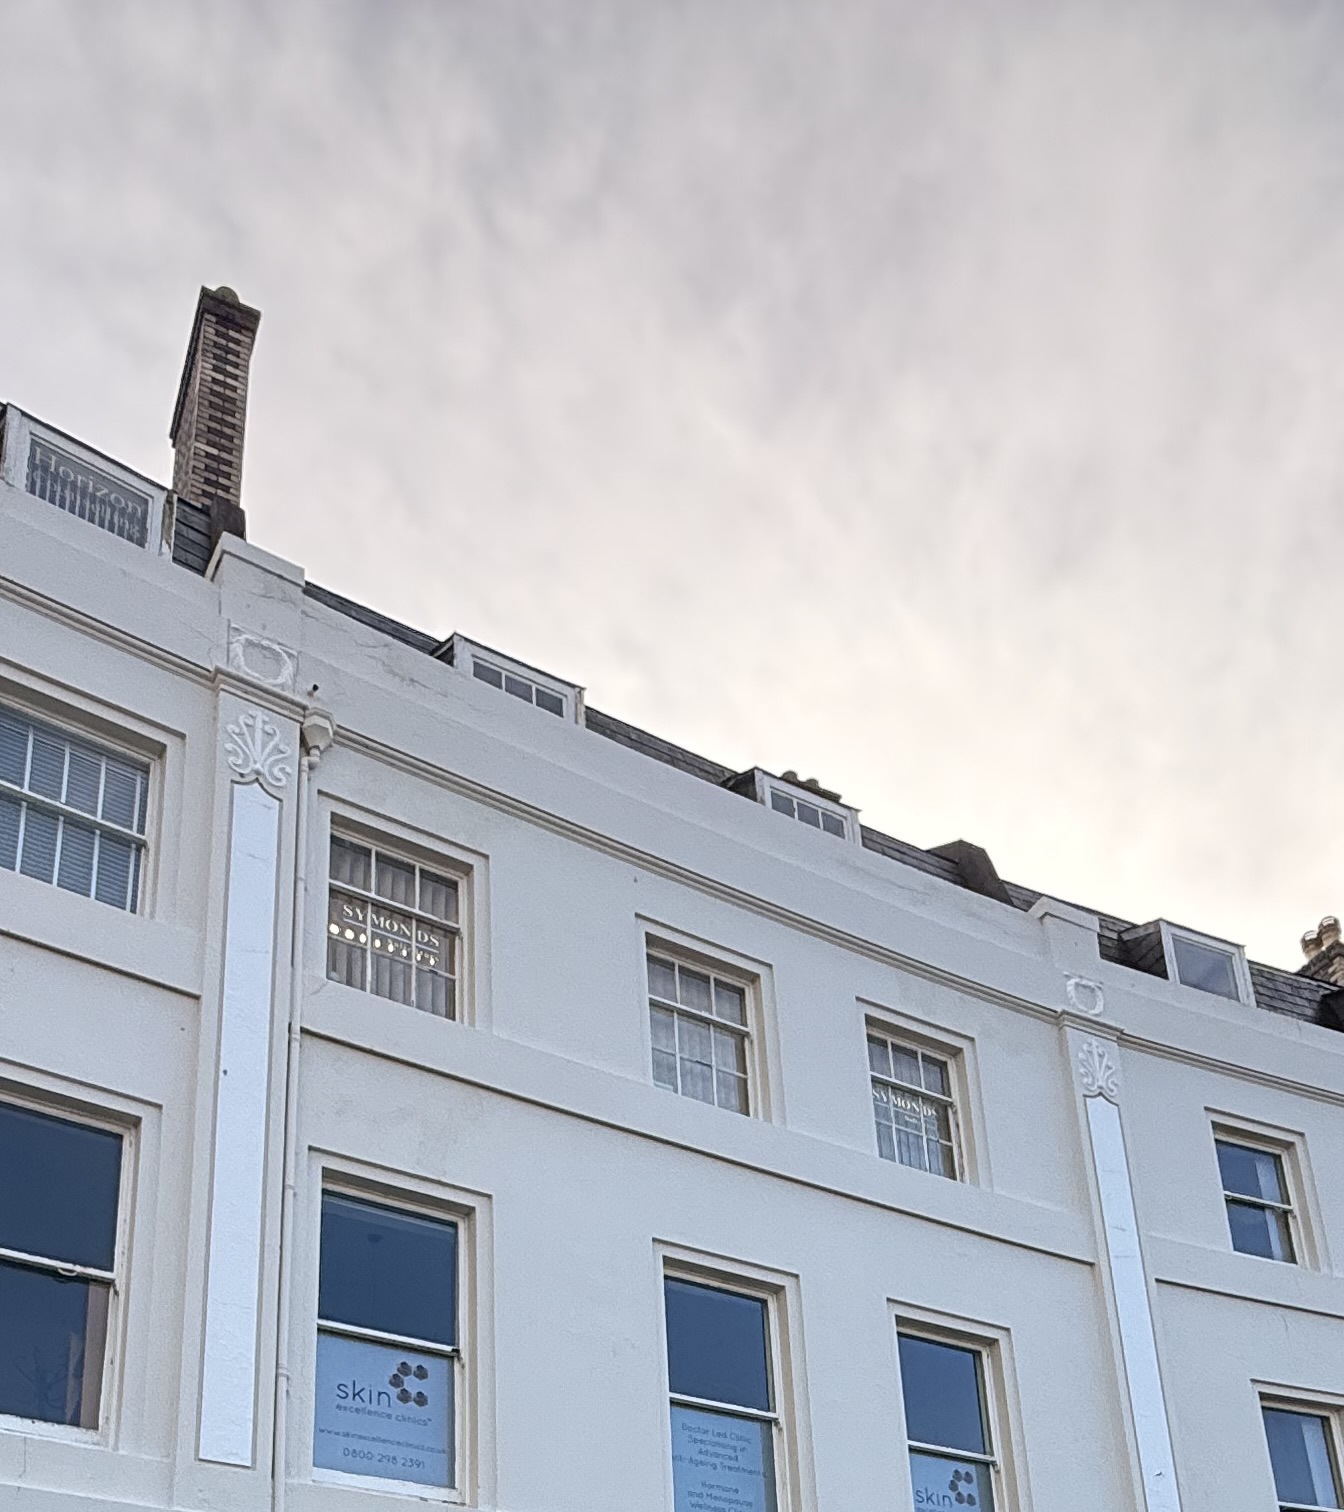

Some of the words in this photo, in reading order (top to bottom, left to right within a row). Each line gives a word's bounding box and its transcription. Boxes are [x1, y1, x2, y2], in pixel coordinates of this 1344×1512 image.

[34, 446, 143, 520] Horizon
[342, 904, 440, 948] SYMONDS
[336, 1380, 391, 1408] skin
[915, 1486, 953, 1509] skin
